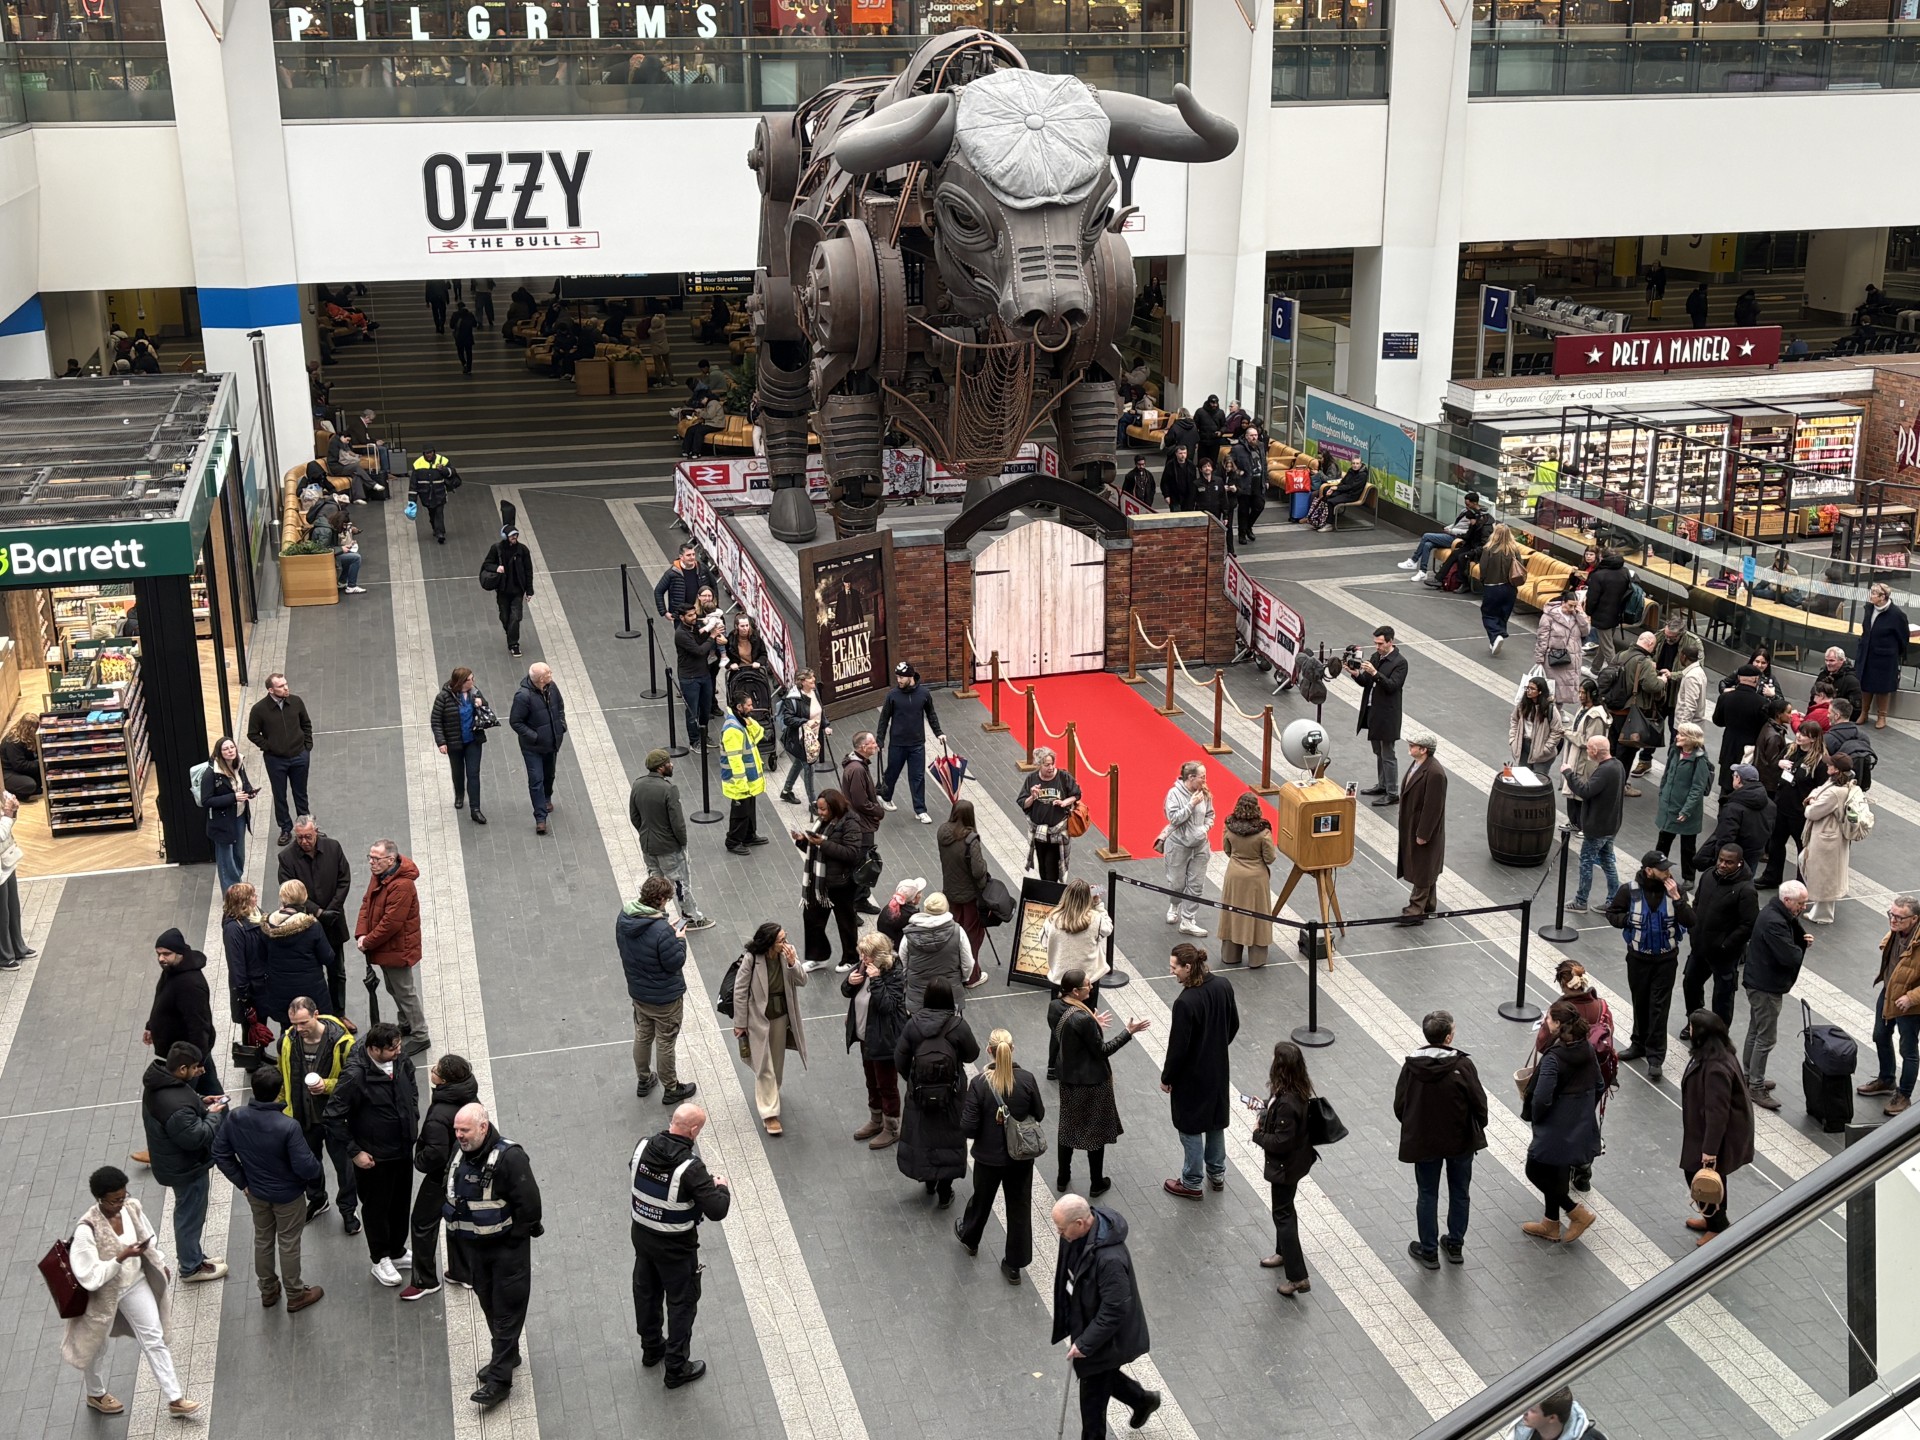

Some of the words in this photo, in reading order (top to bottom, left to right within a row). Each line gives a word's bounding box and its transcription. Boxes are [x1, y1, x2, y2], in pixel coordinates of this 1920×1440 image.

[927, 2, 976, 13] Japanese
[927, 13, 951, 23] food
[422, 150, 593, 232] OZZY
[468, 237, 504, 249] THE
[515, 235, 561, 247] BULL
[1275, 307, 1284, 329] 6
[1489, 297, 1498, 318] 7
[1612, 338, 1650, 366] PRET
[1653, 338, 1663, 364] A
[1670, 336, 1731, 363] MANGER
[1498, 391, 1536, 407] Organic
[1538, 389, 1567, 404] Coffee
[1578, 388, 1603, 400] Good
[1605, 387, 1628, 398] Food
[1325, 410, 1348, 428] Welcome
[1348, 420, 1355, 431] to
[1311, 419, 1341, 438] Birmingham
[1341, 431, 1353, 444] New
[1352, 435, 1369, 450] Street
[9, 538, 146, 575] Barrett
[830, 630, 871, 665] PEAKY
[832, 655, 872, 681] BLINDERS
